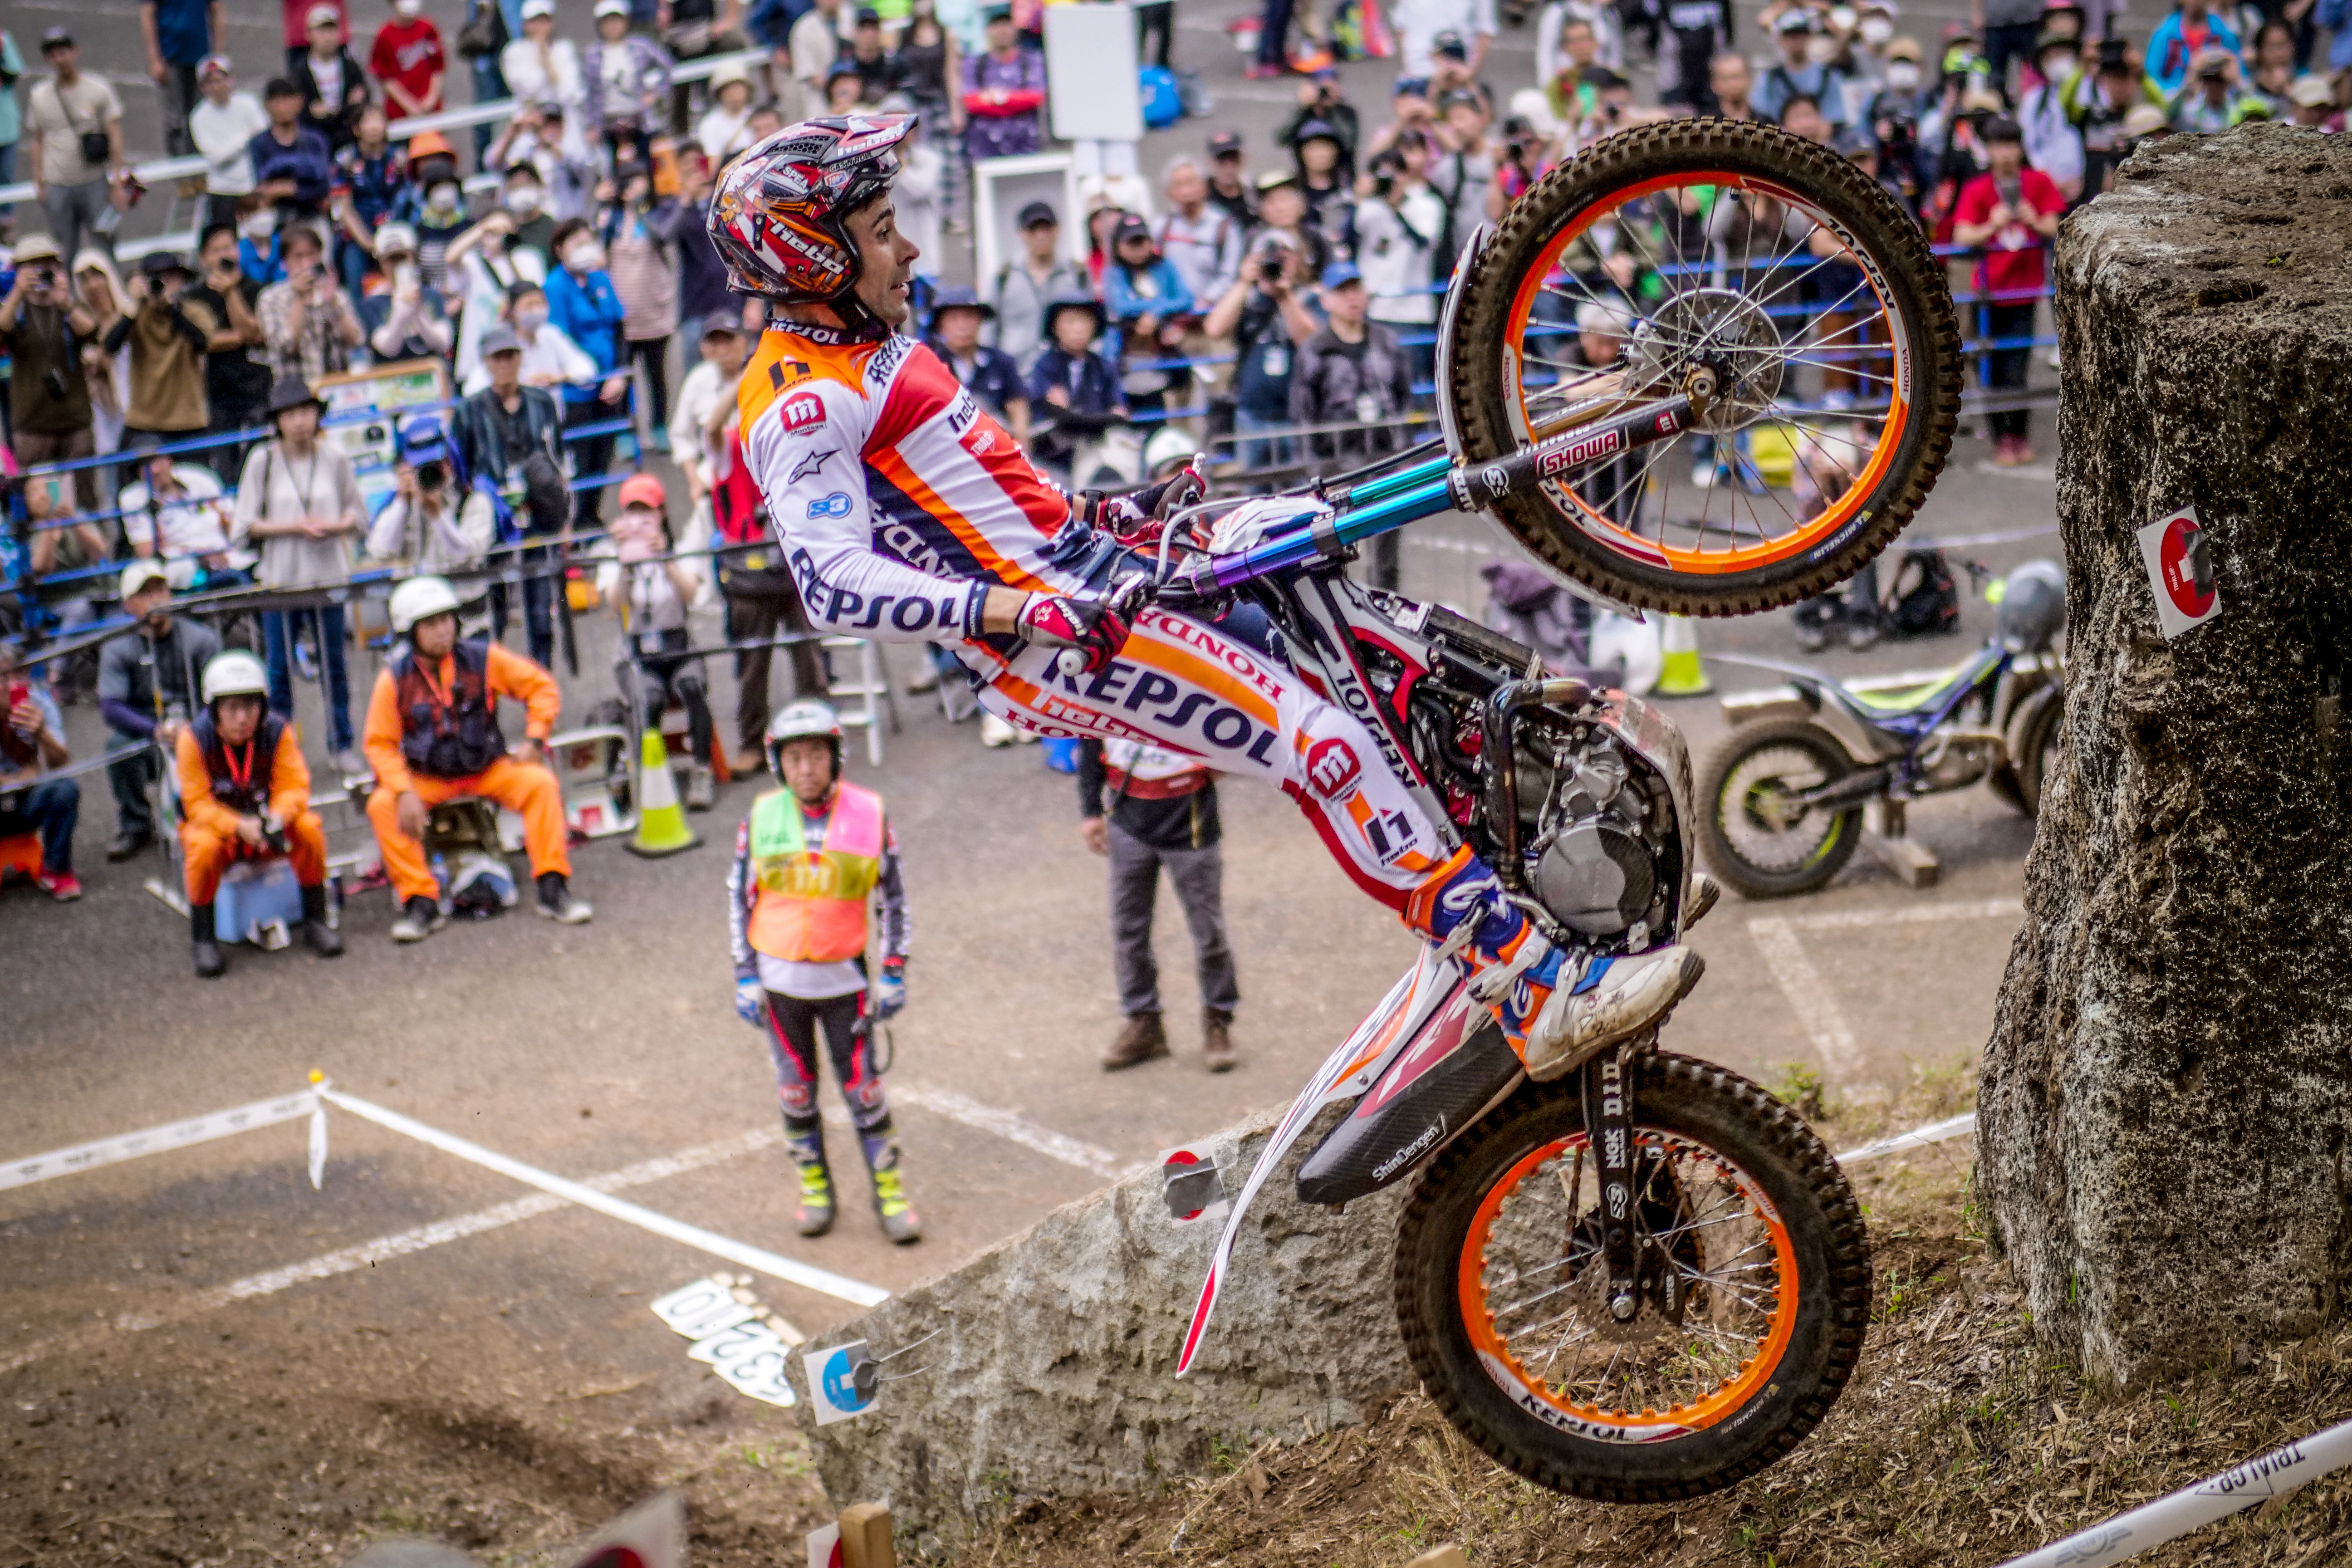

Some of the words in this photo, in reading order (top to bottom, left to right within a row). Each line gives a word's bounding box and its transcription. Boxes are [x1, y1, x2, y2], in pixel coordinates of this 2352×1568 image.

[782, 165, 809, 190] SPEA
[770, 221, 845, 275] hebo
[1504, 357, 1513, 402] HONDA
[1901, 348, 1910, 392] HONDA
[790, 423, 824, 438] Montesa
[947, 395, 976, 436] heb
[1545, 431, 1618, 475] SHOWA
[1544, 476, 1587, 526] SOL
[1813, 527, 1857, 559] MICHELIN
[791, 547, 962, 633] REPSOL
[1132, 610, 1287, 705] HONDA
[1042, 649, 1280, 768] REPSOL
[1337, 669, 1418, 789] REPSOL
[1330, 774, 1363, 804] Montesa
[1381, 837, 1418, 867] hebo
[1468, 1010, 1489, 1033] HON
[1602, 1063, 1623, 1116] DID
[1604, 1129, 1619, 1168] NGK
[1522, 1393, 1630, 1442] REPSOL
